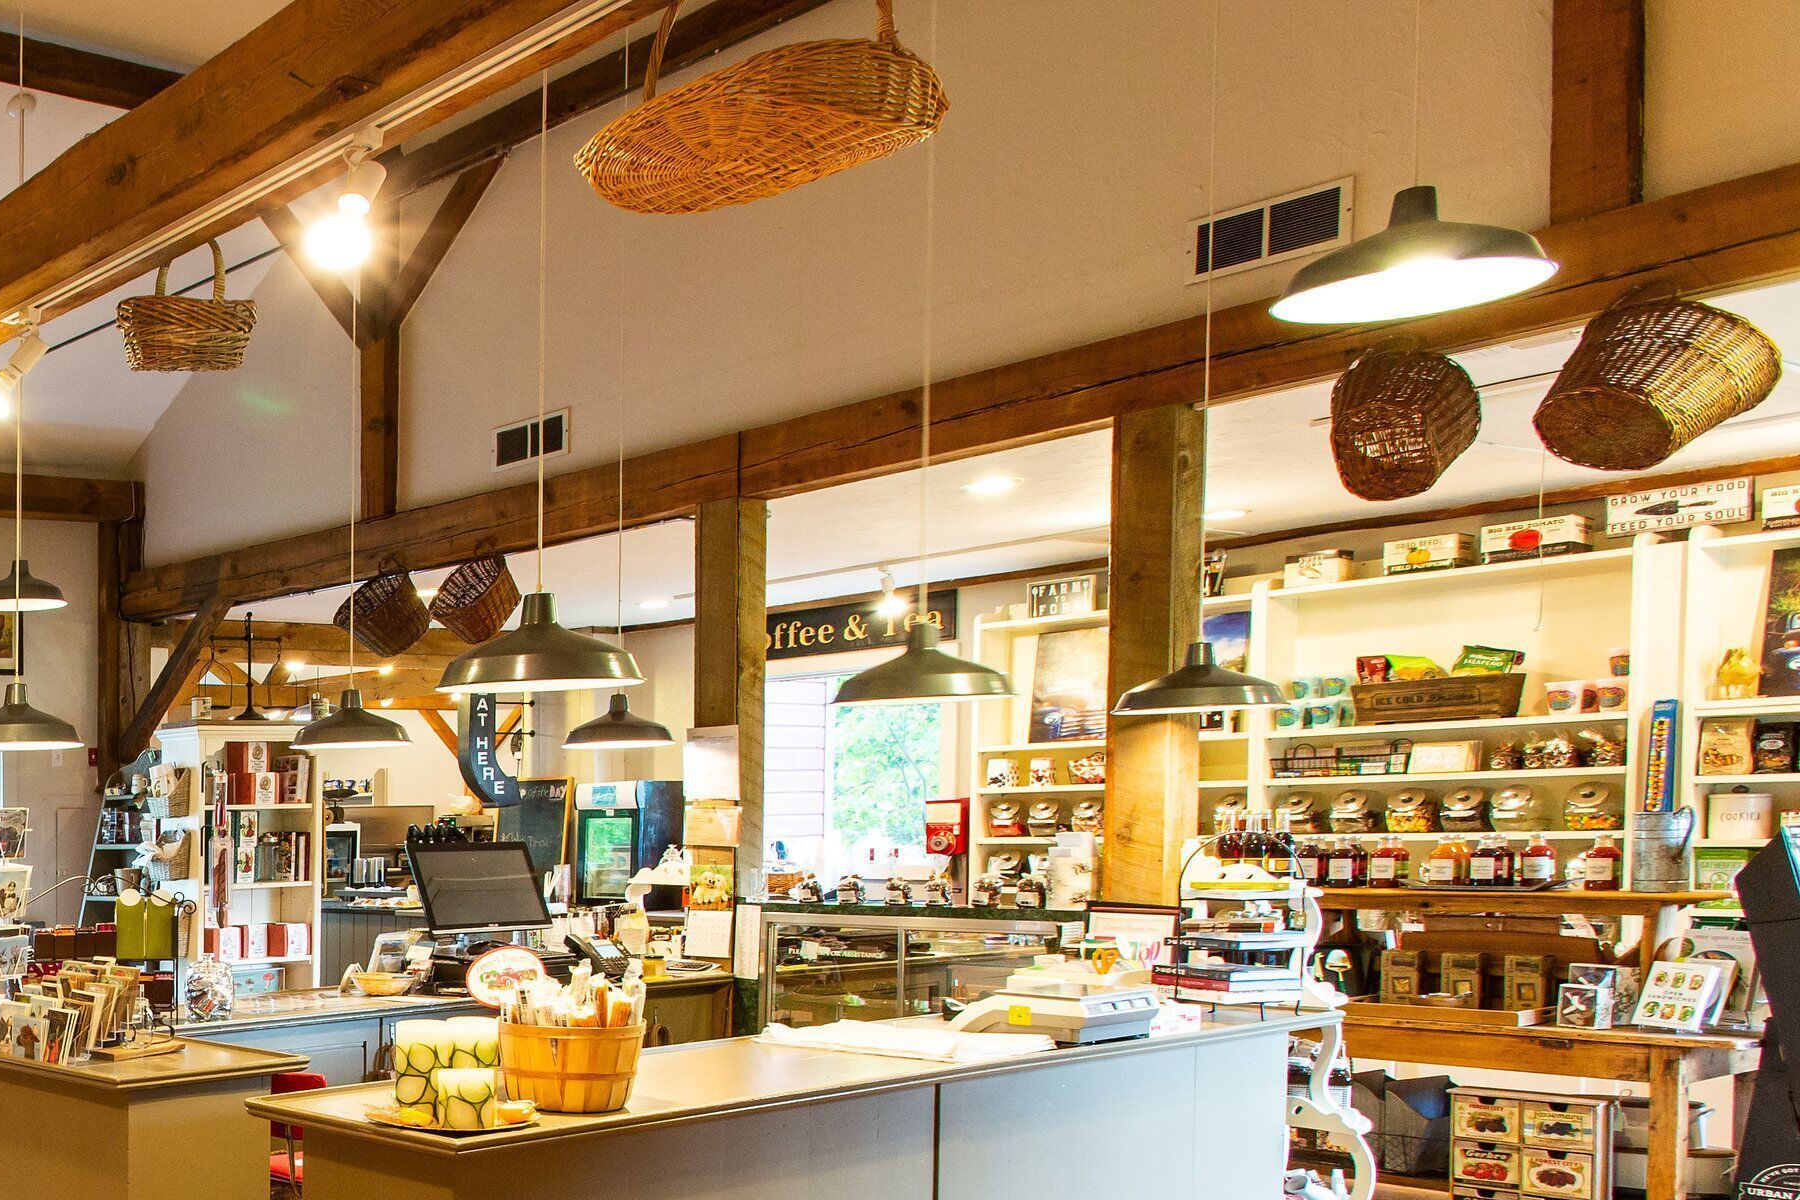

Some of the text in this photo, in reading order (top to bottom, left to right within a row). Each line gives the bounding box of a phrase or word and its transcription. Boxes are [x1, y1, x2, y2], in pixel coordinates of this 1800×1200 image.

[1610, 480, 1746, 507] GROW YOUR FOOD
[1486, 518, 1566, 535] BIG RED TOMATO
[1610, 508, 1746, 533] FEED YOUR SOUL
[1038, 581, 1082, 598] FARM
[1054, 595, 1067, 604] TO
[1038, 602, 1074, 617] FOR
[843, 613, 869, 641] &
[1375, 696, 1392, 707] ICE
[1394, 694, 1424, 706] COLD
[475, 693, 489, 727] AT
[476, 736, 505, 795] HERE
[527, 786, 535, 798] of
[537, 785, 549, 797] the
[549, 785, 567, 799] DAY
[1648, 993, 1698, 1003] SANDWICHES
[1468, 1103, 1490, 1111] FOREST
[1533, 1111, 1584, 1121] Rosemary
[1534, 1157, 1582, 1168] FOREST CITY
[1746, 1186, 1794, 1200] URBAN
